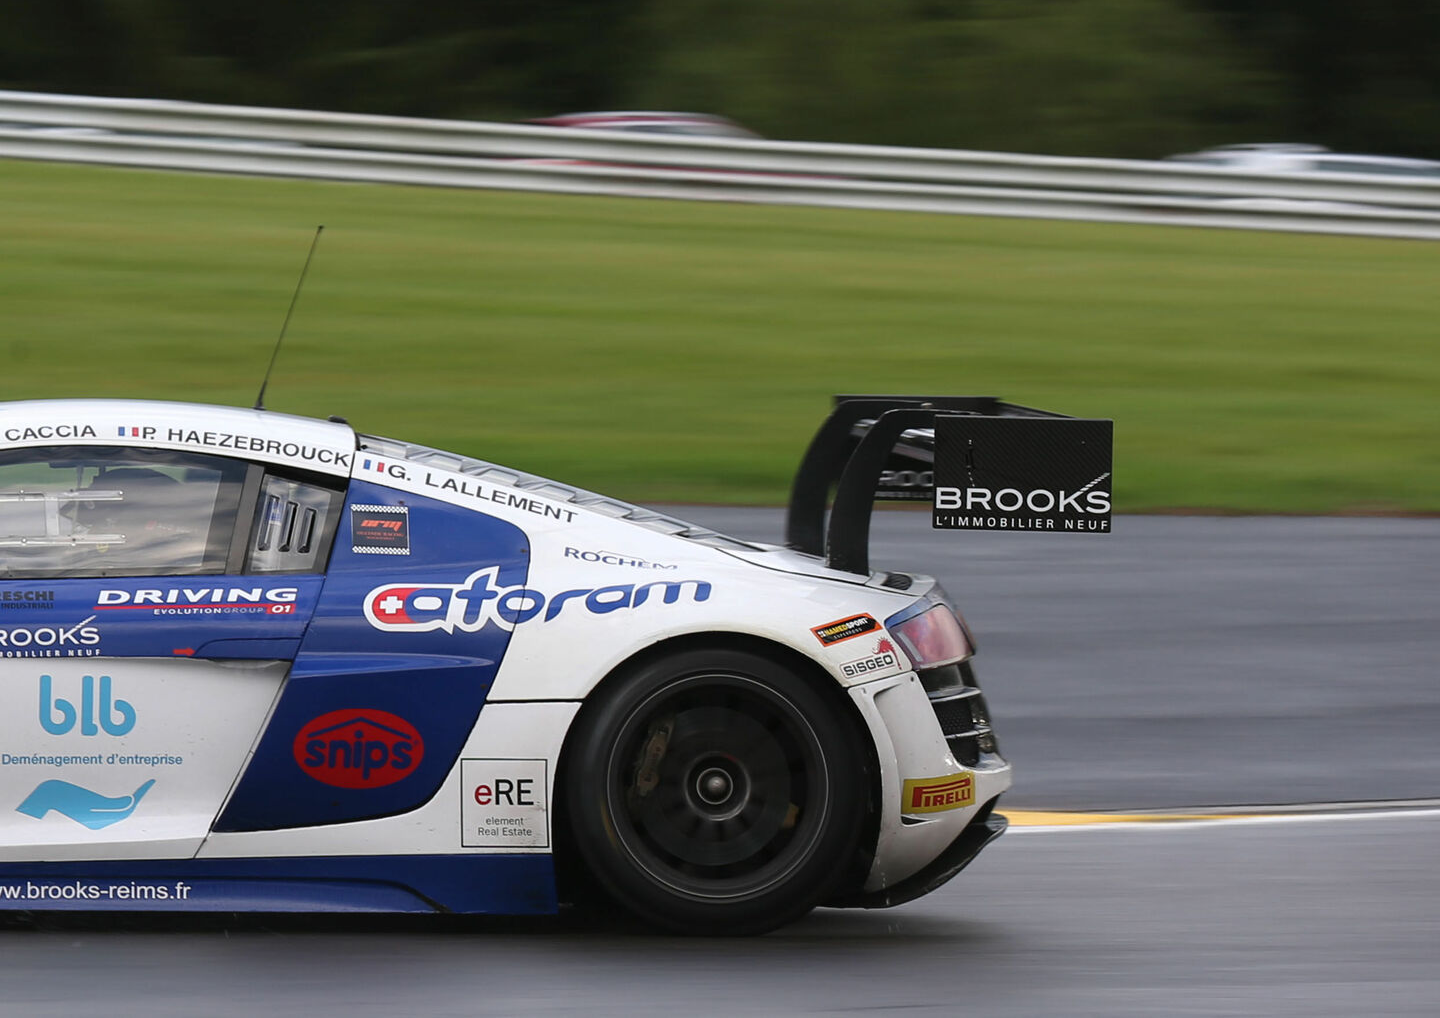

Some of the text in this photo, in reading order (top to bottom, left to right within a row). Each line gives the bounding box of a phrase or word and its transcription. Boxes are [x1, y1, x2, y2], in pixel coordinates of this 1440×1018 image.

[5, 425, 97, 441] CACCIA
[142, 426, 350, 468] P. HAEZEBROUCK
[387, 464, 579, 524] G. LALLEMENT
[935, 473, 1111, 514] BROOKS
[936, 515, 1109, 530] L'IMMOBILIER NEUF
[97, 588, 298, 605] DRIVING
[371, 569, 712, 624] atoram
[270, 604, 291, 614] 01
[68, 649, 101, 657] NEUF
[843, 654, 894, 677] SISGEO
[39, 675, 137, 737] blb
[1, 753, 183, 767] Deménagement d'entreprise
[304, 730, 413, 780] snips
[474, 779, 534, 806] eRE
[911, 778, 971, 808] PIRELLI
[477, 826, 532, 837] Real Estate
[485, 816, 524, 826] element
